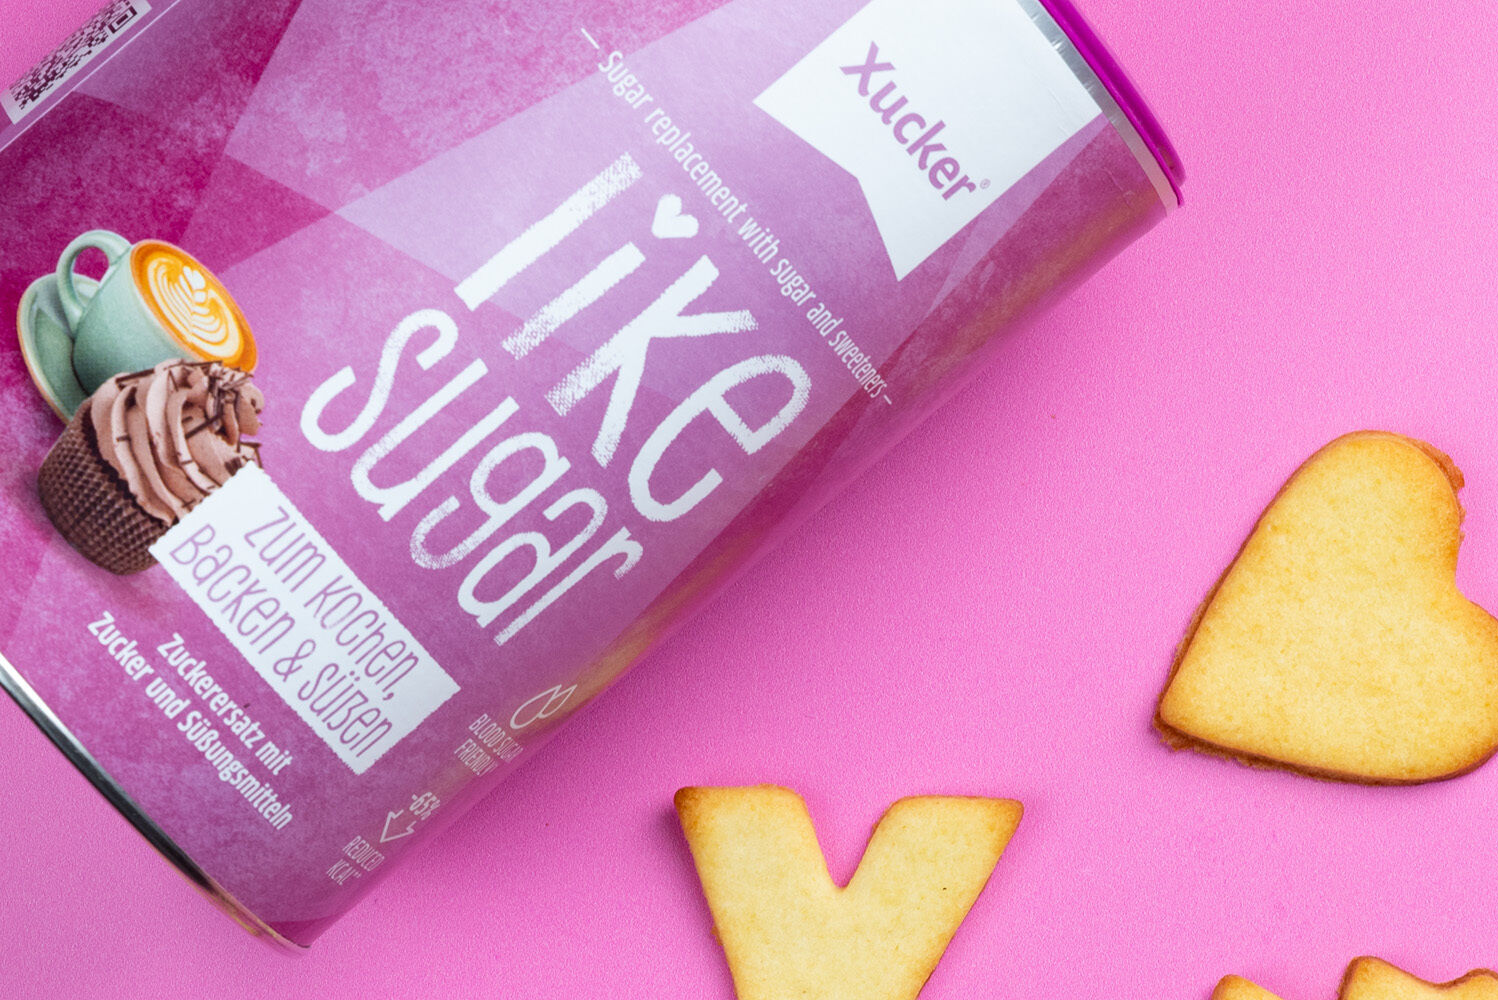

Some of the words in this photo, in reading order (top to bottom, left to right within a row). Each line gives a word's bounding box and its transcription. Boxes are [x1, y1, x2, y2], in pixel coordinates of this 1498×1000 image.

[598, 51, 654, 109] Sugar
[644, 107, 748, 224] replacement
[738, 217, 781, 264] with
[770, 258, 816, 306] sugar
[806, 302, 844, 337] and
[828, 330, 888, 399] sweeteners
[300, 308, 644, 647] sugar
[87, 610, 154, 681] Zucker
[145, 677, 191, 720] und
[177, 710, 293, 830] Süßungsmitteln
[156, 632, 265, 749] Zuckerersatz
[255, 741, 293, 776] mit
[273, 639, 316, 682] &
[468, 713, 506, 748] BLOOD
[342, 835, 385, 872] REDUCED
